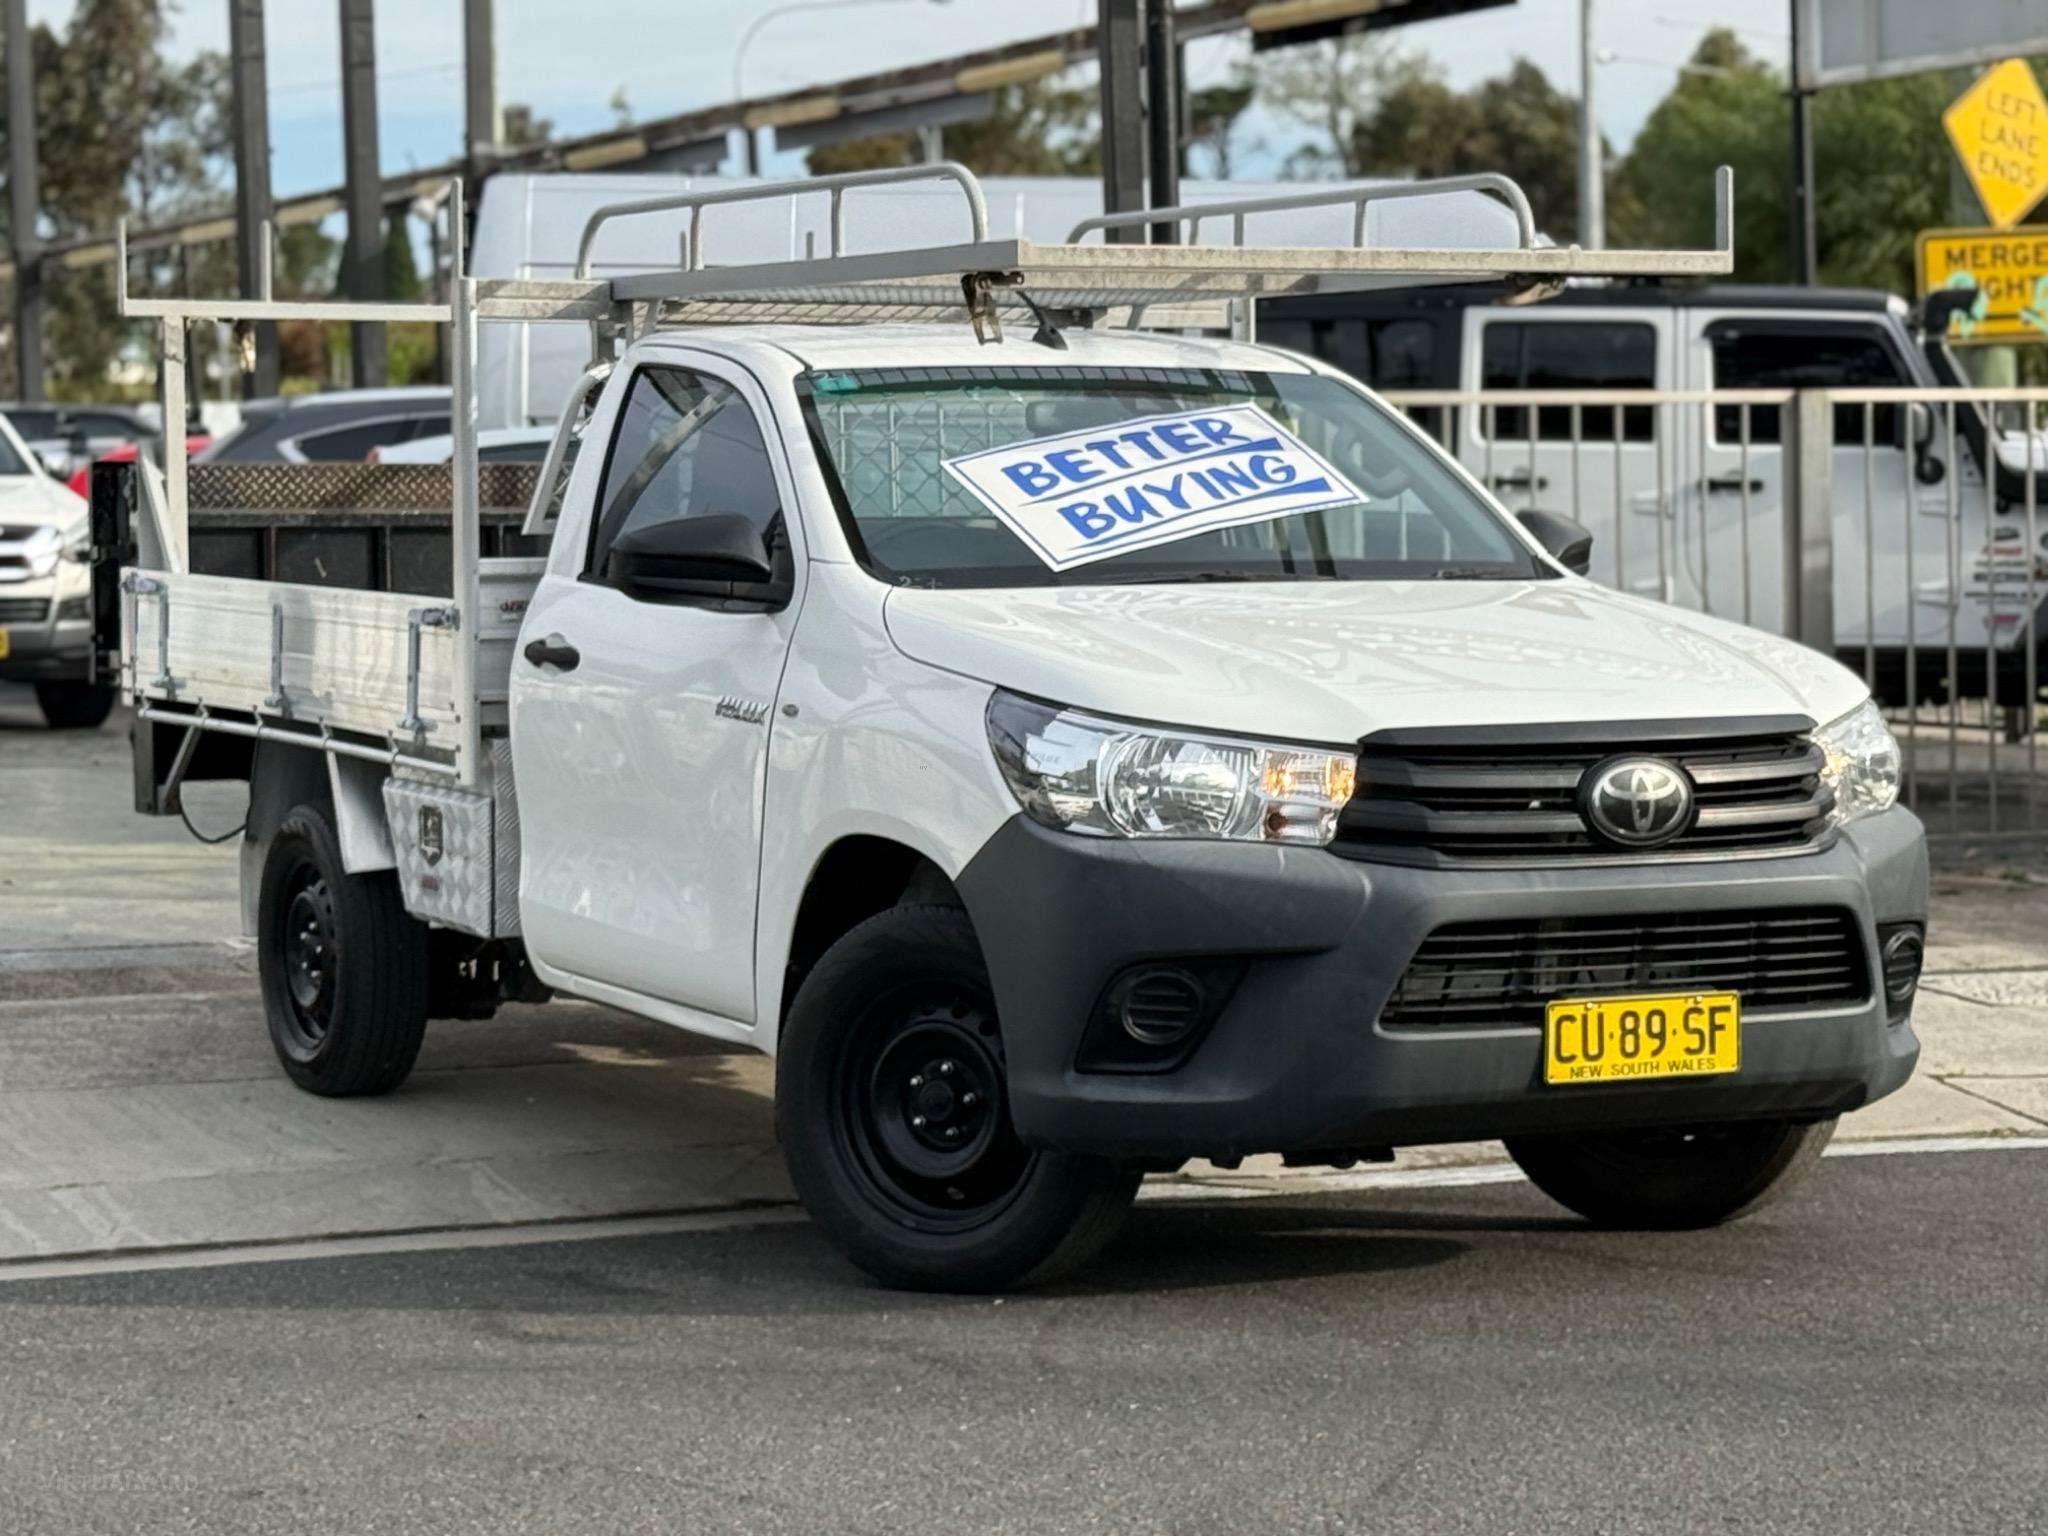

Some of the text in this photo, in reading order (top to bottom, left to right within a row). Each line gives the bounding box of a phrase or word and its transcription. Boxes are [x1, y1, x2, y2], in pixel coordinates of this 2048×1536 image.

[1986, 88, 2037, 126] LEFT
[1980, 116, 2042, 159] LANE
[1979, 150, 2036, 189] ENDS
[1945, 241, 2048, 270] MERGE
[1001, 418, 1255, 497] BETTER
[1056, 455, 1297, 538] BUYING
[1570, 1057, 1716, 1080] NEW SOUTH WALES
